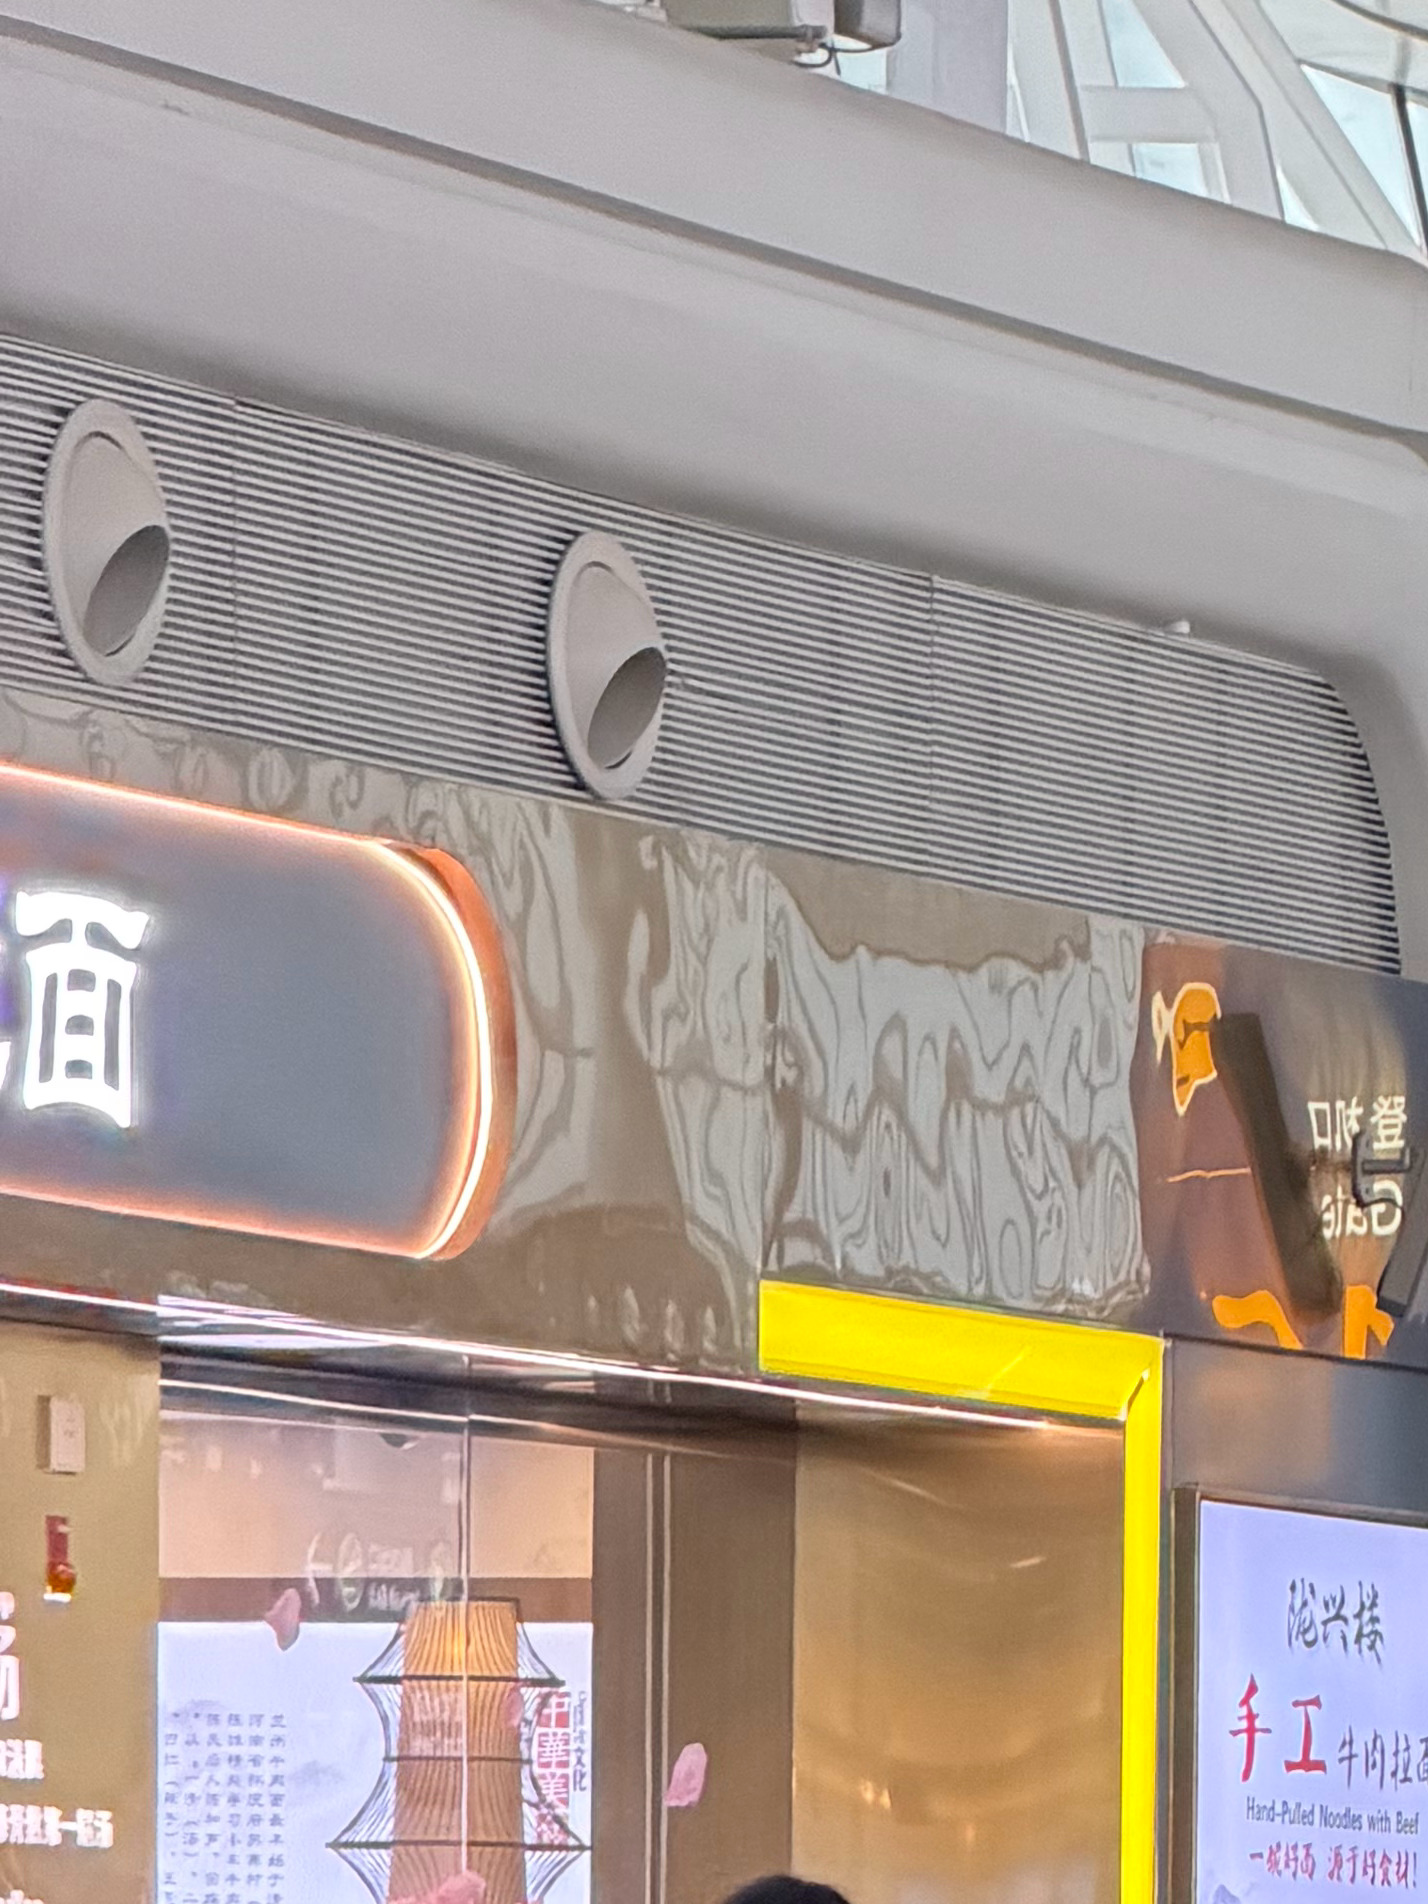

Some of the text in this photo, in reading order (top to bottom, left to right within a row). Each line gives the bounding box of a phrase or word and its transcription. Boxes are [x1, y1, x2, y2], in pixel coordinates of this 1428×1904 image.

[1246, 1796, 1420, 1835] Hand-Pulled Noodles with Beef
